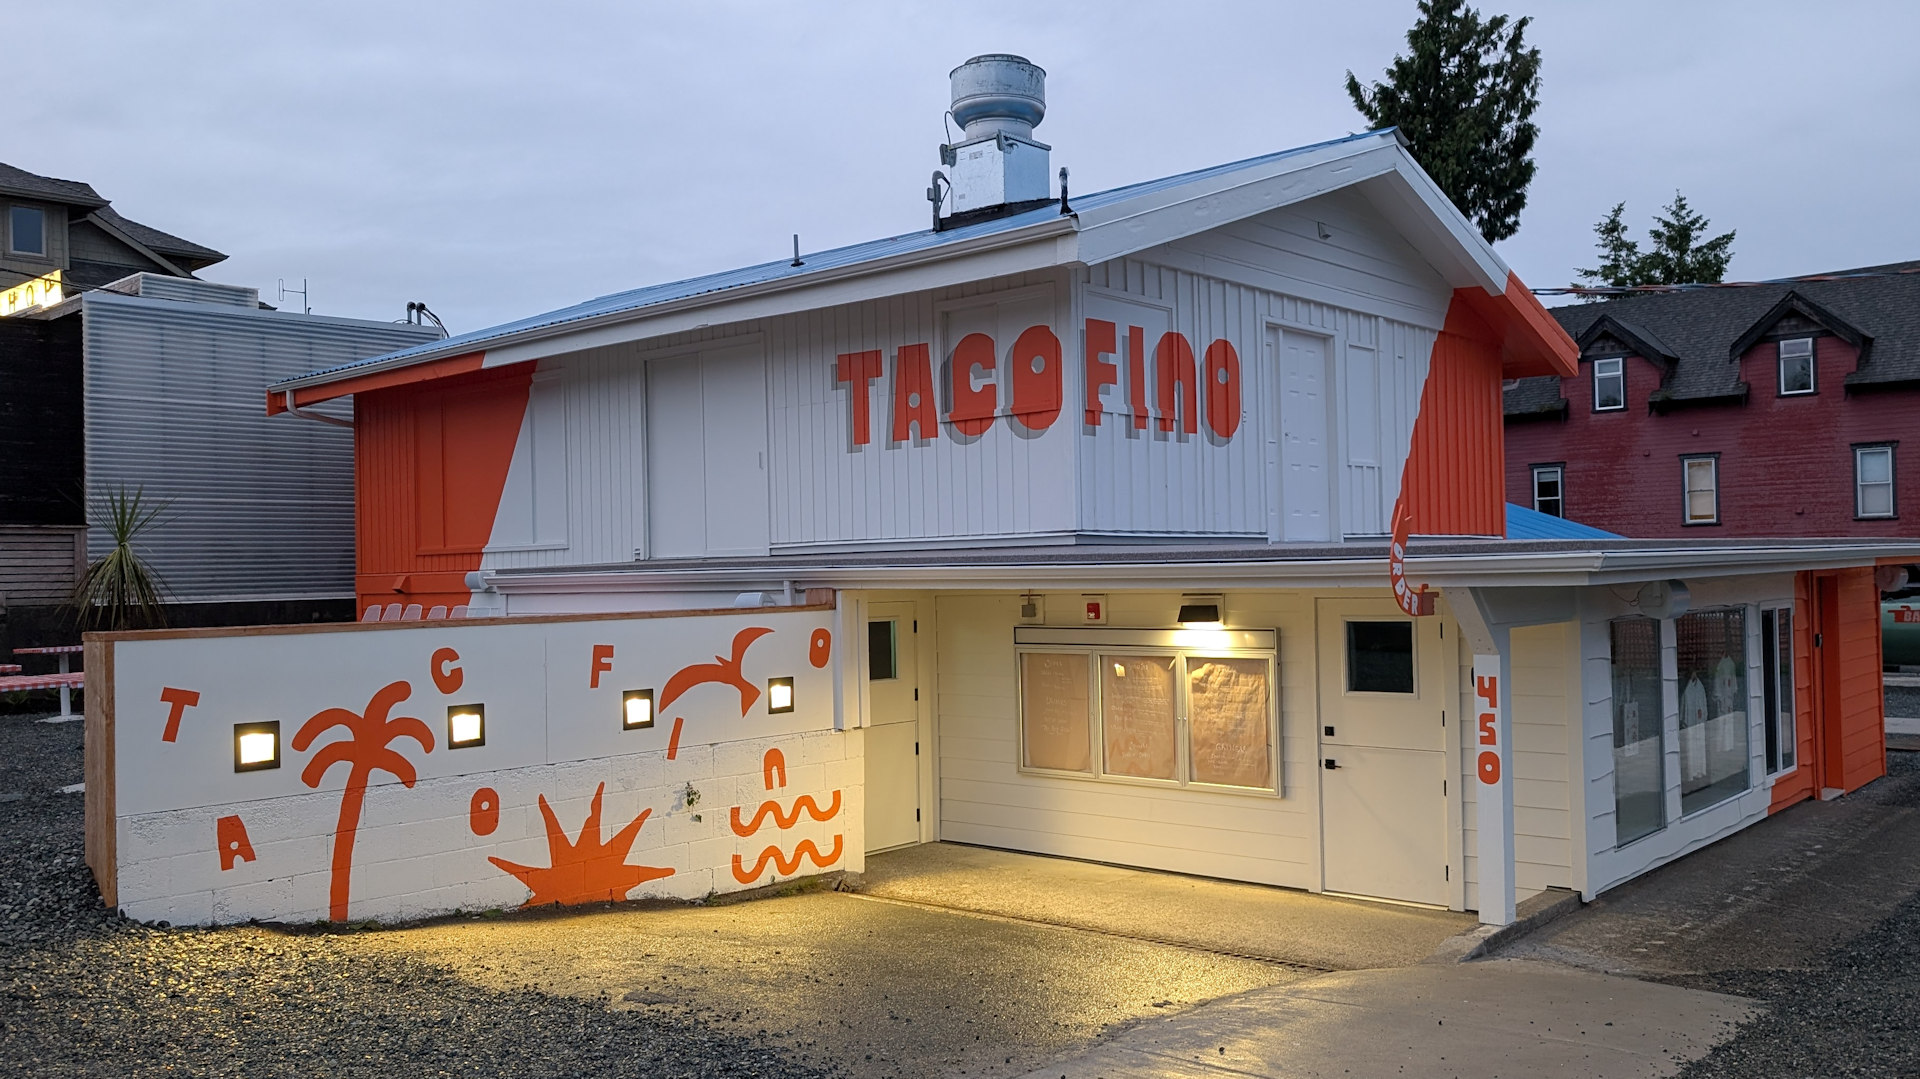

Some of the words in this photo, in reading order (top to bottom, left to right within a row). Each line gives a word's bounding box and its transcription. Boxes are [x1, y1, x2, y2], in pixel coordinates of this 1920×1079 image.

[835, 324, 1063, 447] TACO
[1084, 317, 1241, 439] FINO
[1393, 542, 1419, 616] ORDER
[590, 645, 615, 689] F
[808, 628, 832, 669] O
[161, 687, 200, 743] T
[217, 815, 257, 871] A
[469, 787, 500, 837] O
[1477, 675, 1501, 785] 450
